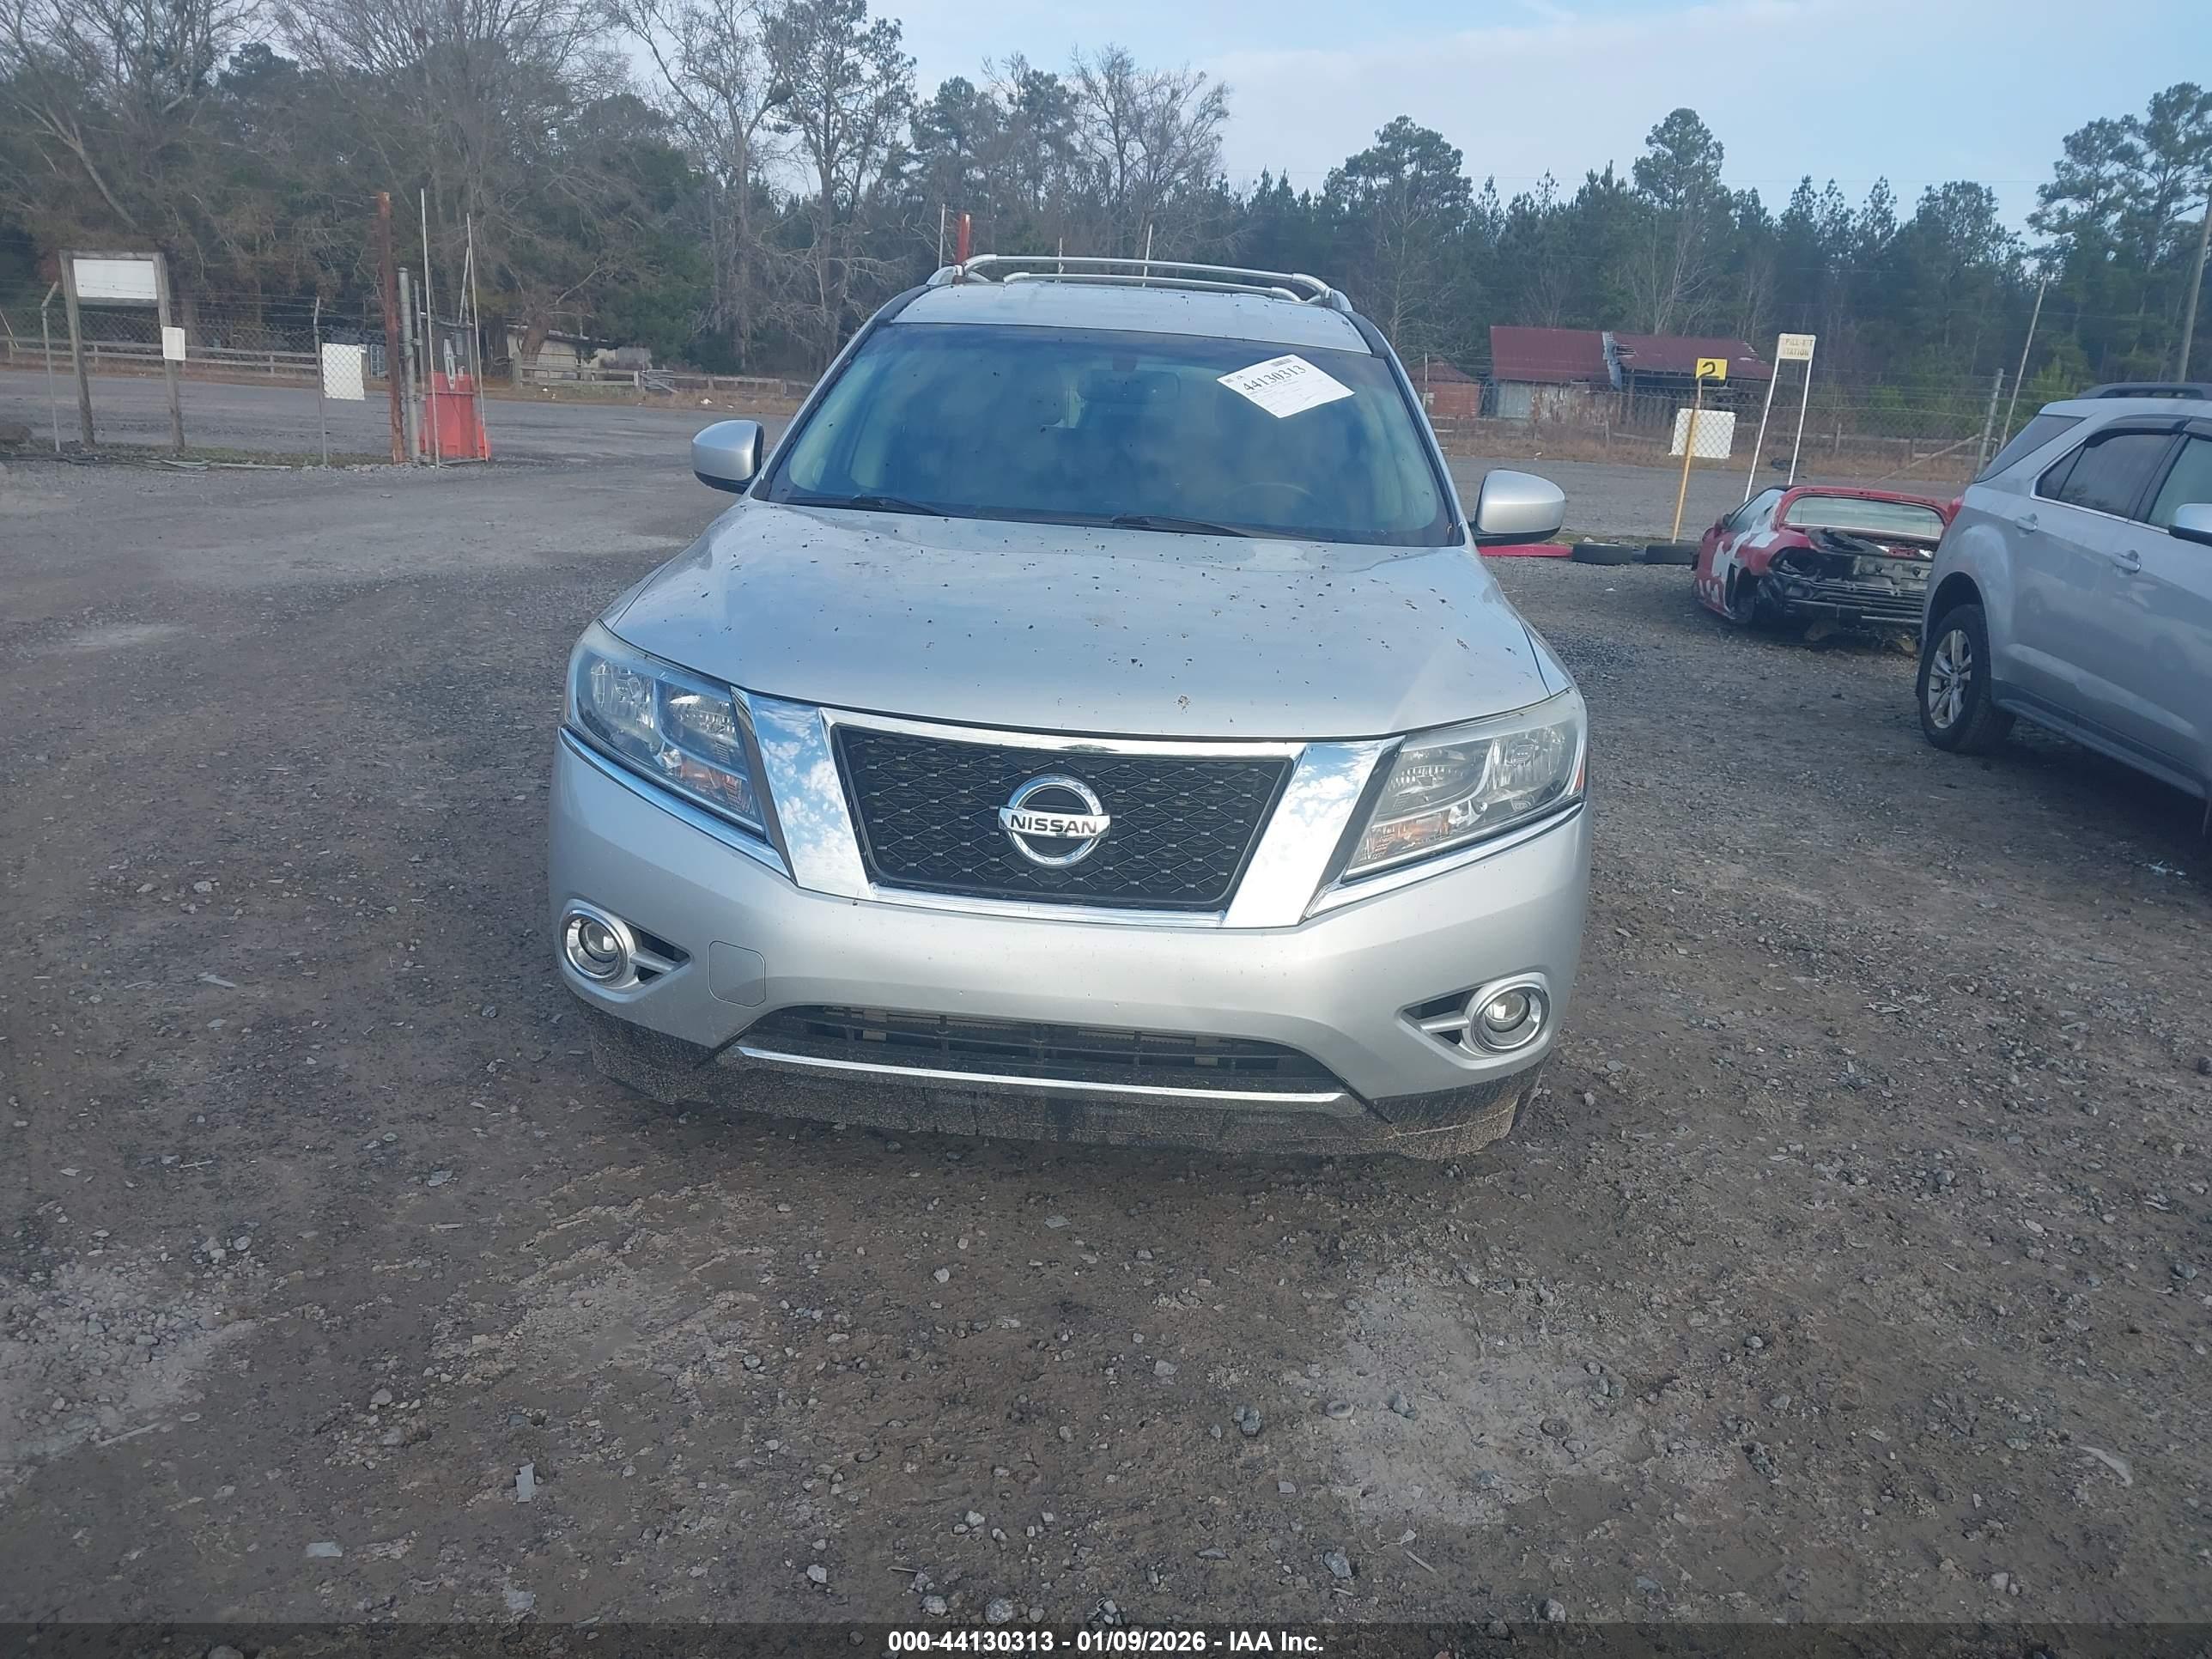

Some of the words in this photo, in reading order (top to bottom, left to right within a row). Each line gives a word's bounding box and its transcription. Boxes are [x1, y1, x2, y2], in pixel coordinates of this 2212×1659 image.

[1243, 365, 1307, 392] 44130313
[1698, 361, 1720, 379] 2
[1011, 814, 1097, 834] NISSAN
